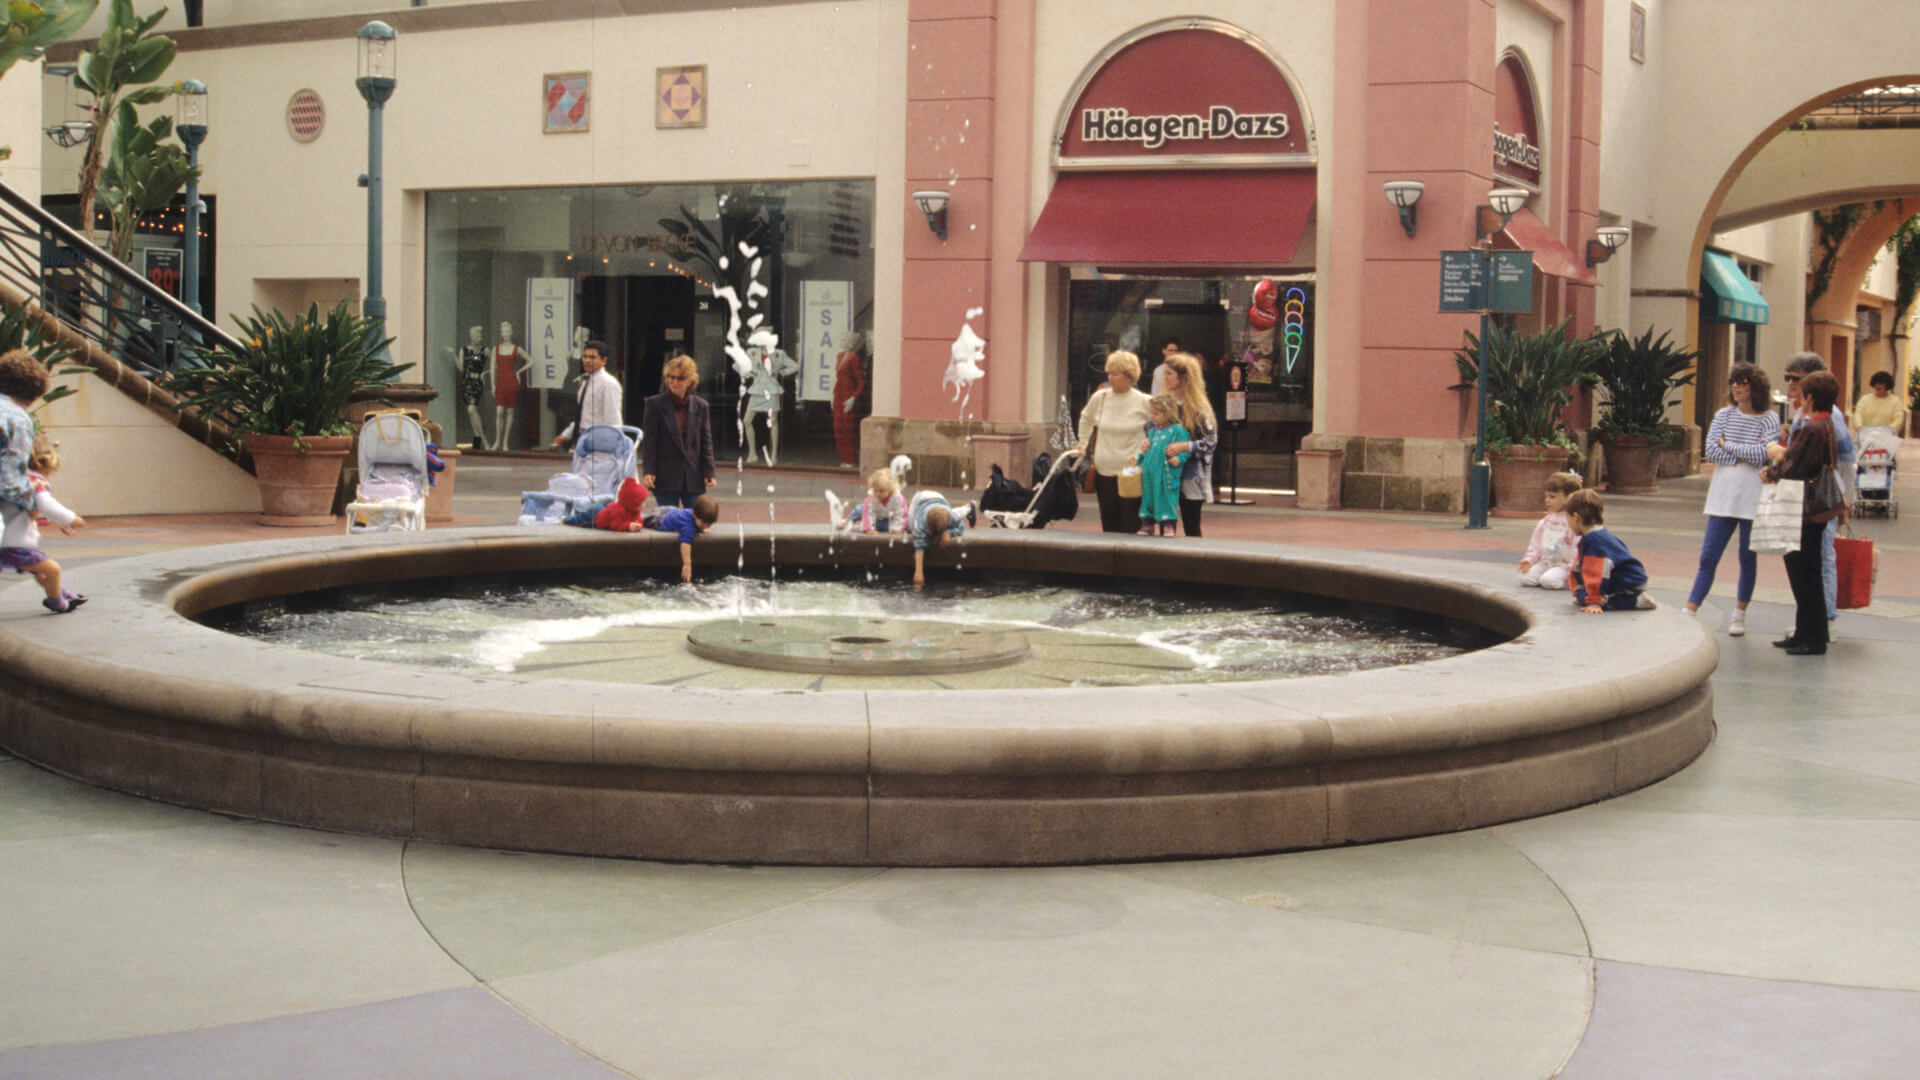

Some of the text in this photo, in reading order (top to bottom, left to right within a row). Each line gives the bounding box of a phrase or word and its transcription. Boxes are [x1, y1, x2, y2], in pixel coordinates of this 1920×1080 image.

[1083, 106, 1289, 148] Häagen-Dazs
[1493, 121, 1539, 170] agen-Dazs
[544, 303, 555, 380] SALE
[819, 308, 832, 392] SALE
